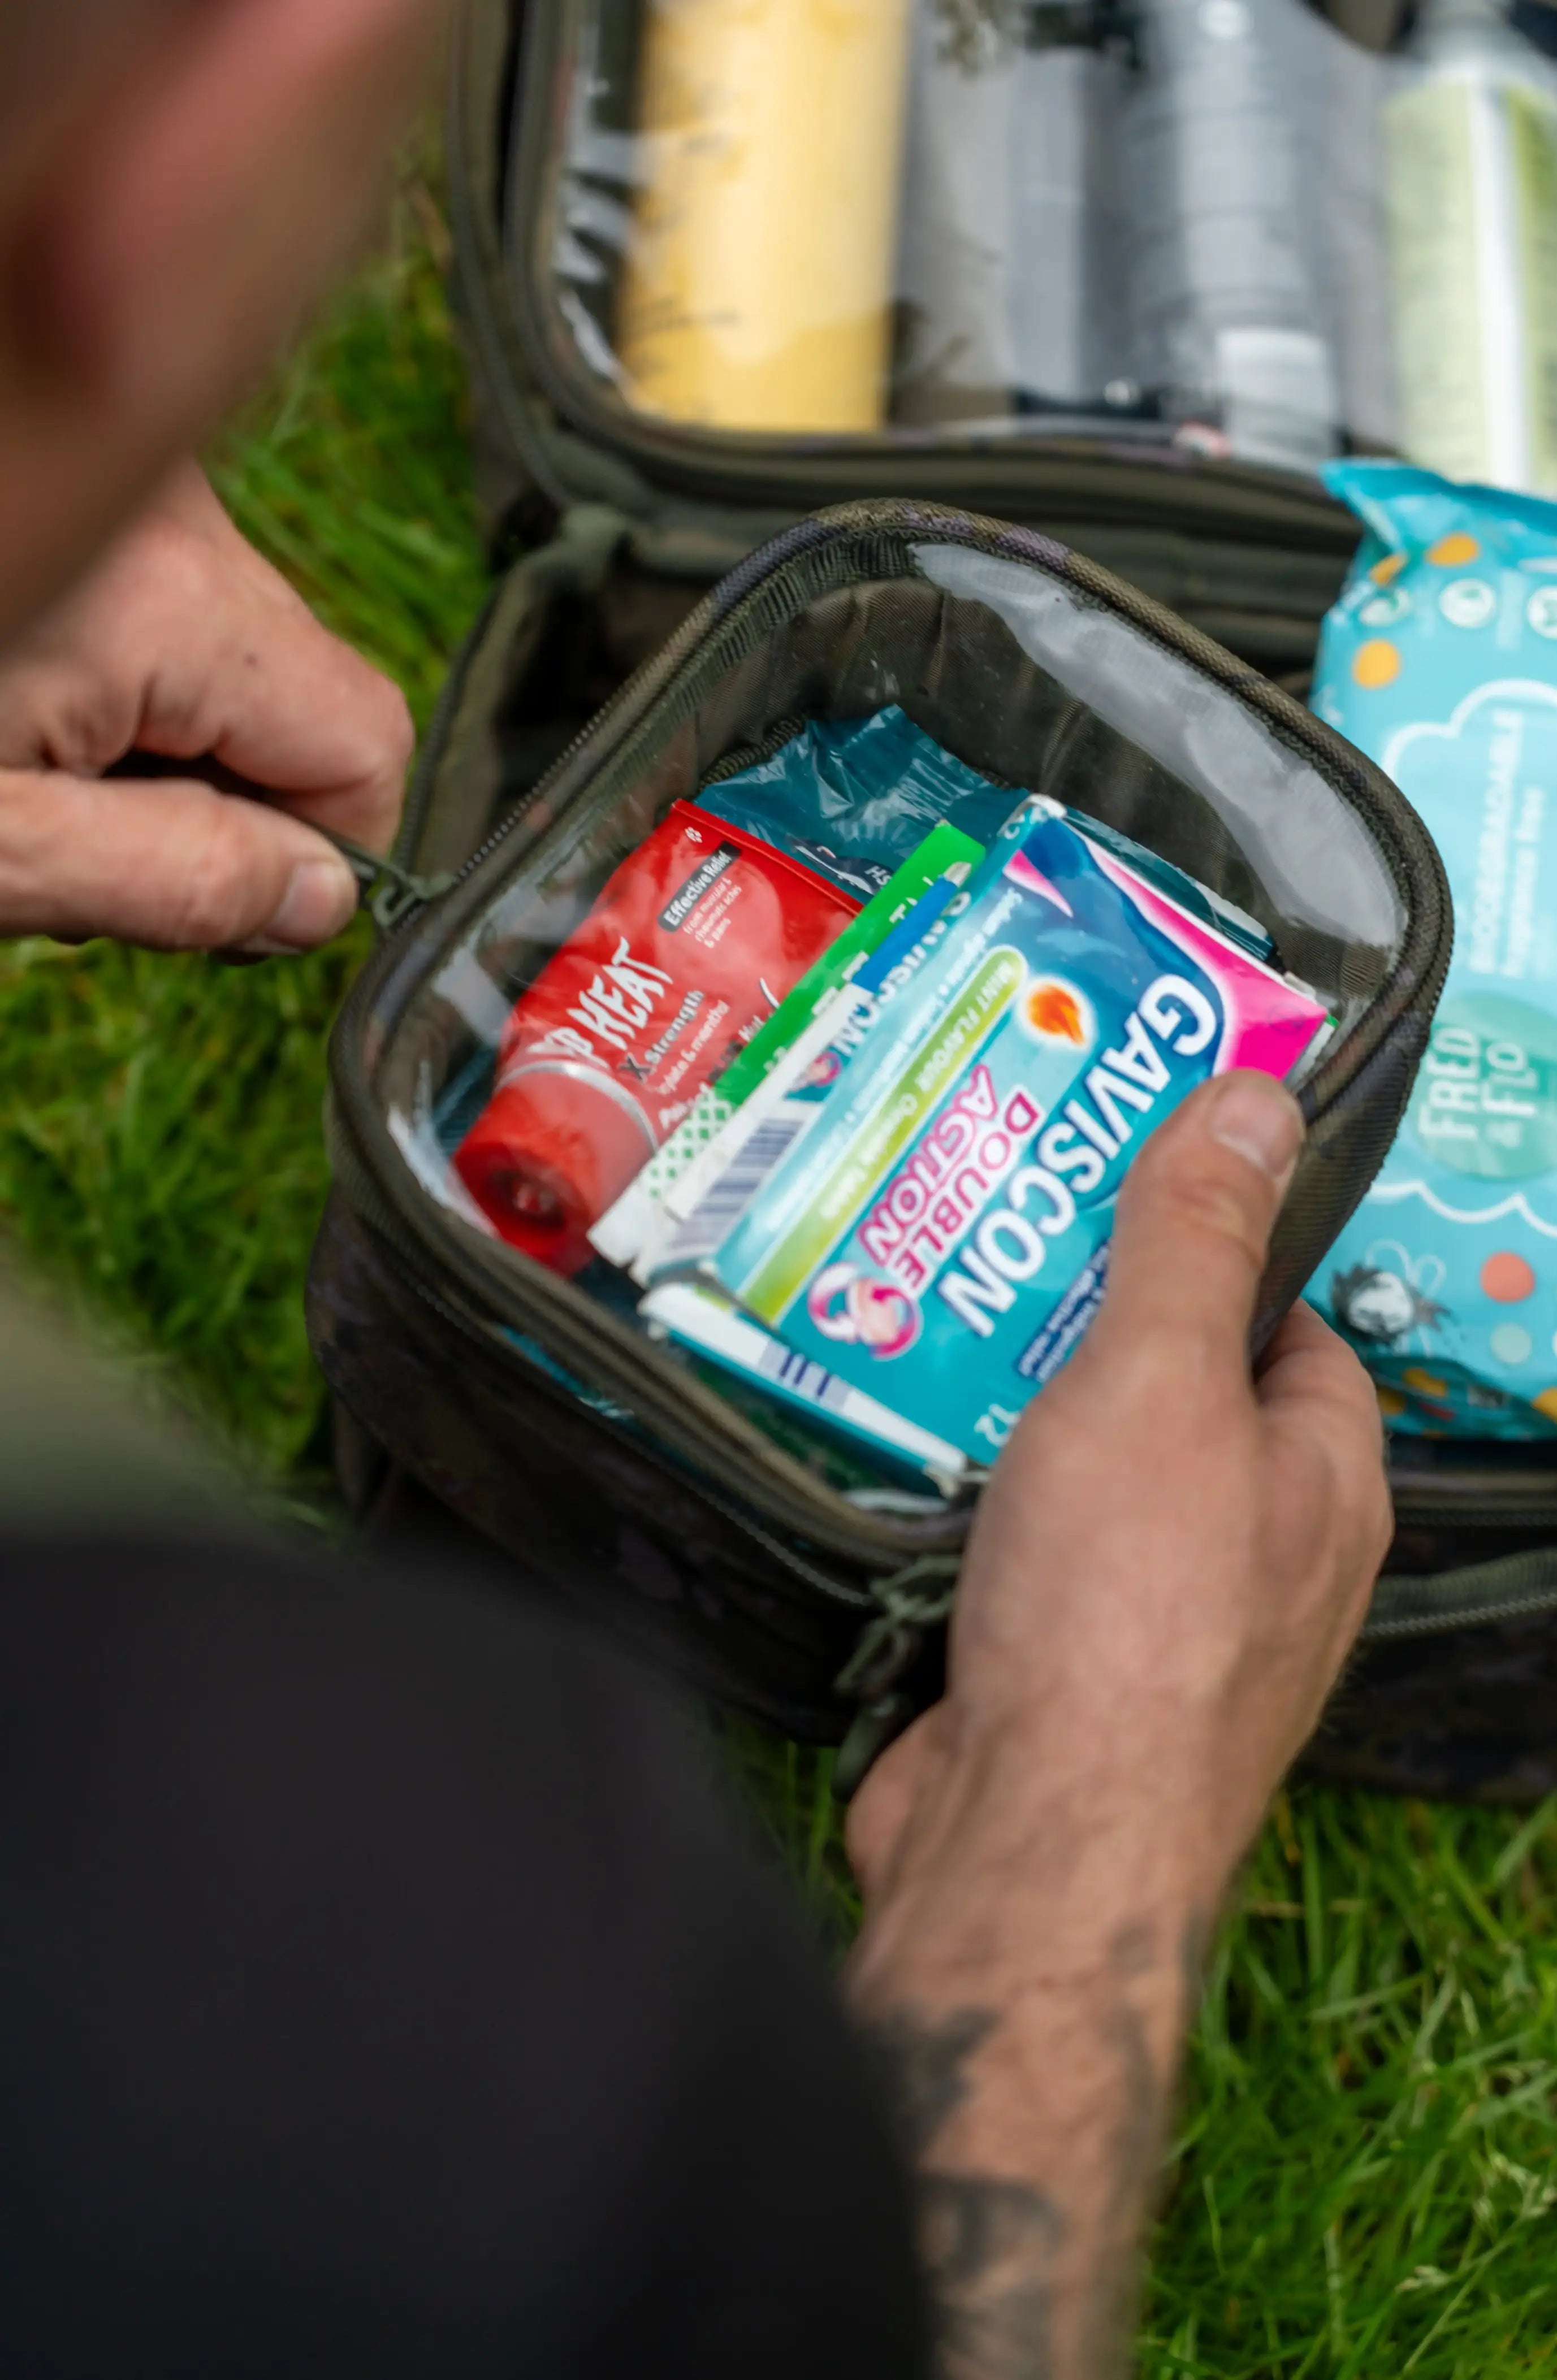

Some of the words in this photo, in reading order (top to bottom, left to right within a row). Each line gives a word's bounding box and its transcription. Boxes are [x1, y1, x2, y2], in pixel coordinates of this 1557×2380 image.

[663, 870, 712, 926] Effective
[702, 849, 732, 878] Relief
[576, 936, 673, 1051] HEAT
[643, 989, 705, 1065] Strength
[972, 959, 1017, 1011] MINT
[911, 1005, 983, 1093] FLAVOUR
[1420, 1027, 1481, 1141] FRED
[1480, 1042, 1539, 1119] FLO
[857, 1064, 998, 1265] ACTION
[893, 1089, 1042, 1290] DOUBLE
[938, 974, 1216, 1337] GAVISCON
